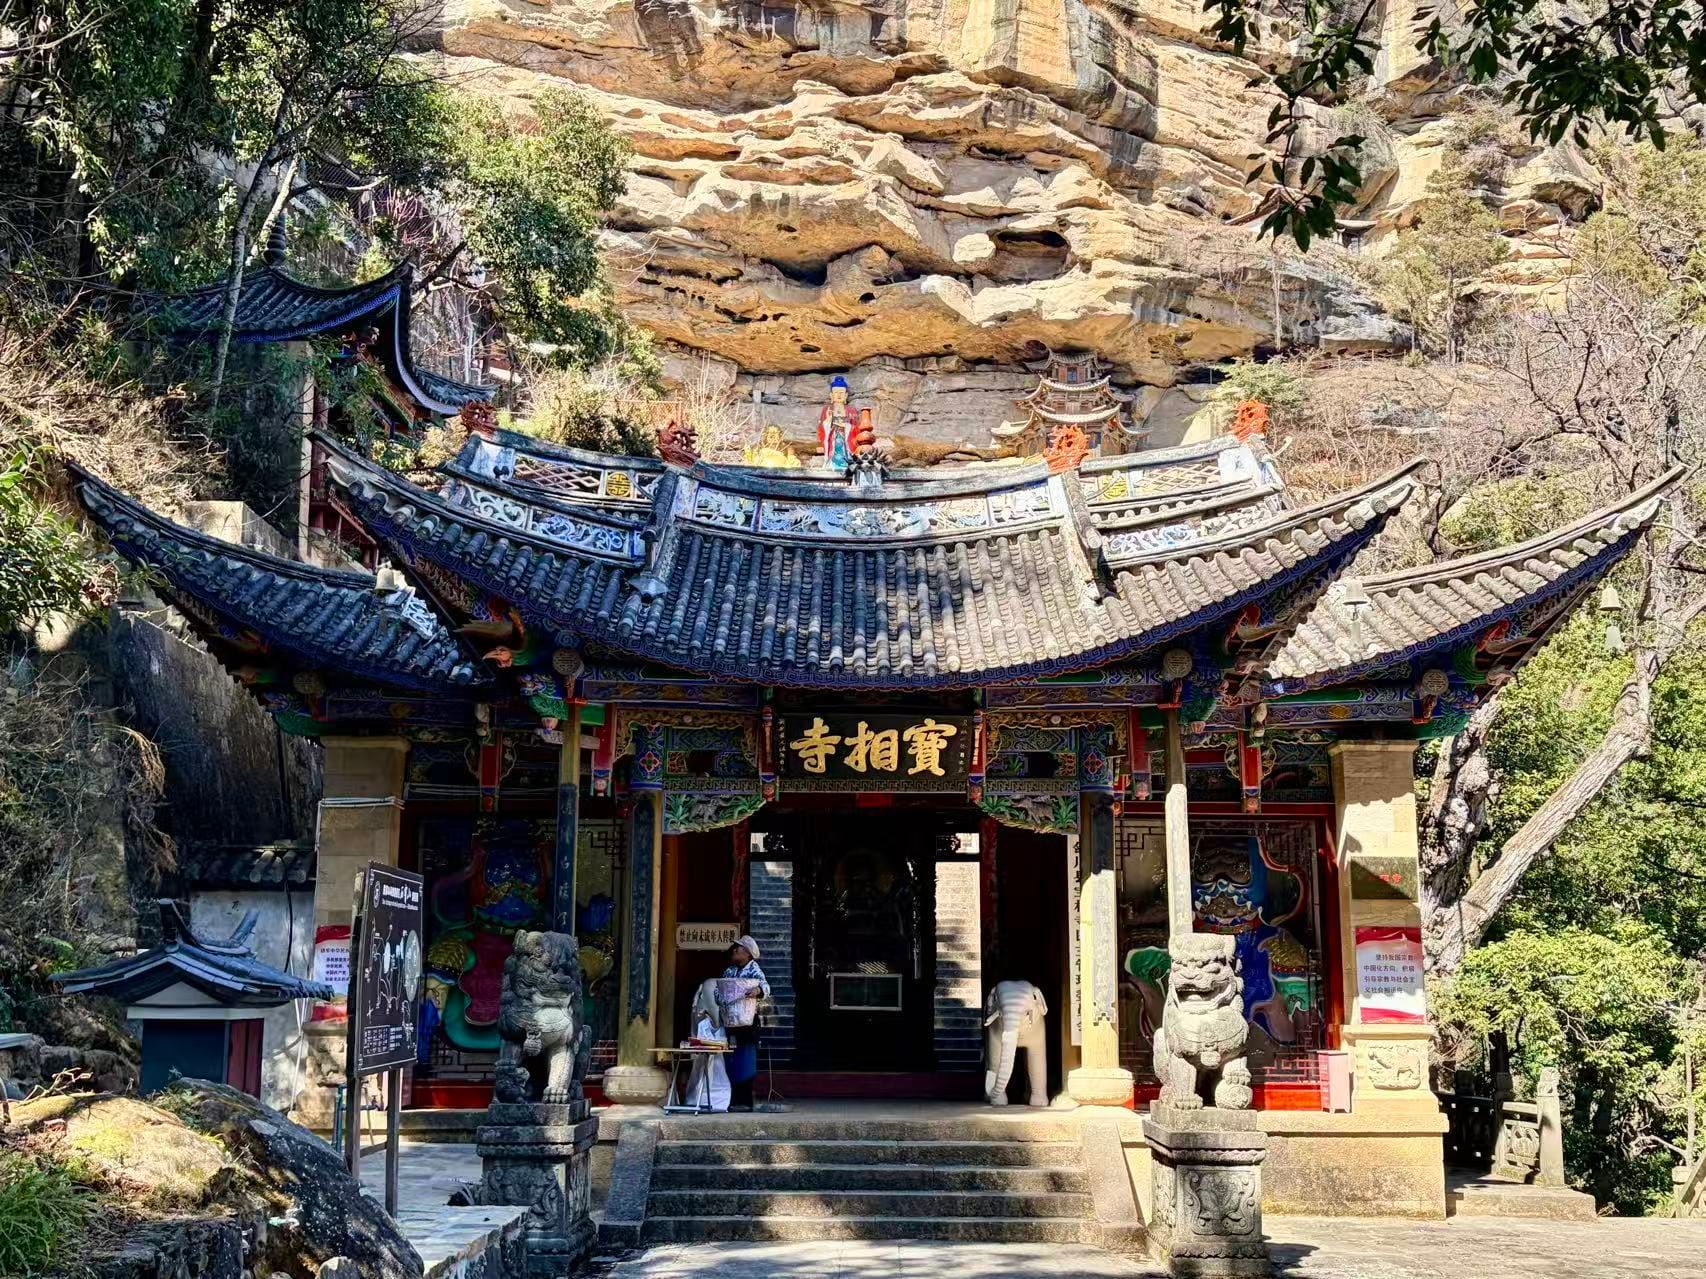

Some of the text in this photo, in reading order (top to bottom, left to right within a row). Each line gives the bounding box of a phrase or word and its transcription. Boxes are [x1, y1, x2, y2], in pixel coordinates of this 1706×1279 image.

[790, 717, 957, 777] 寶相寺
[679, 928, 736, 944] 禁止向未成年人传教
